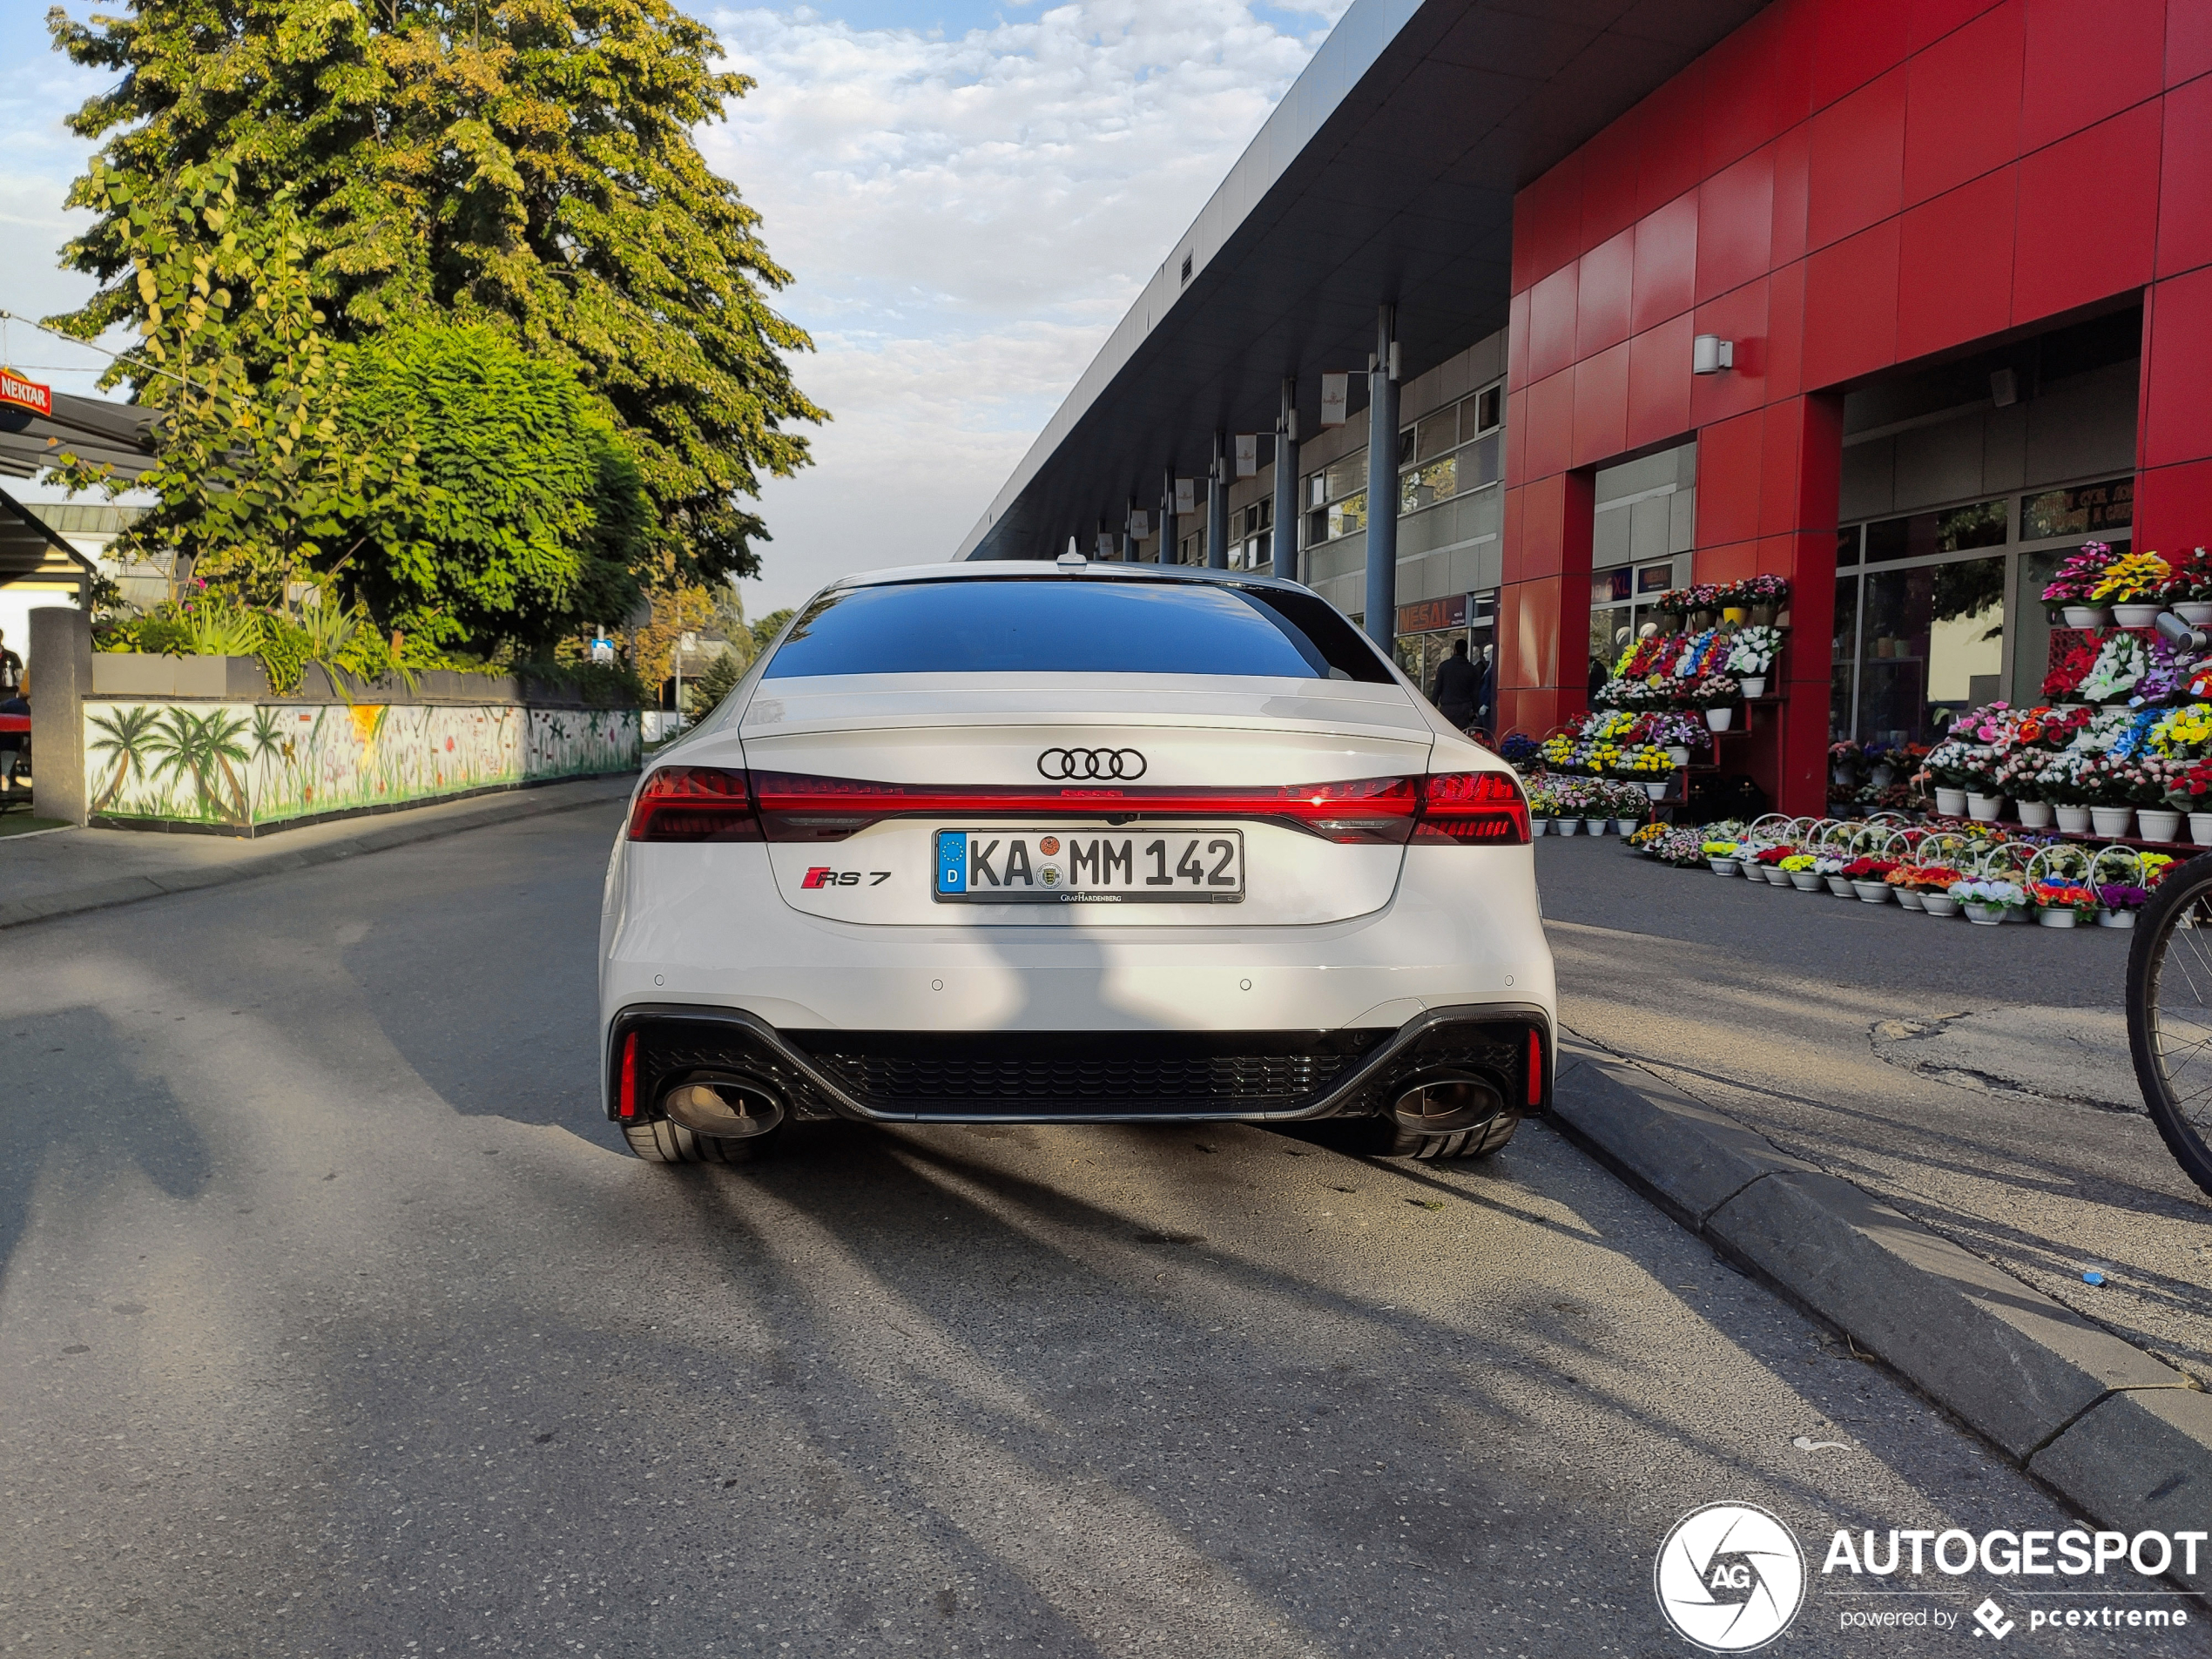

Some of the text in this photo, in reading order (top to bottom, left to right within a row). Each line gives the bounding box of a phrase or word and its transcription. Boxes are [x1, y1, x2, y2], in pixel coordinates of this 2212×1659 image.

[1, 375, 47, 408] NEKTAR
[1399, 601, 1450, 633] NESAL
[815, 872, 892, 887] RS 7
[947, 868, 958, 883] D
[970, 840, 1034, 887] KA
[1069, 840, 1132, 886] MM
[1145, 840, 1236, 886] 142
